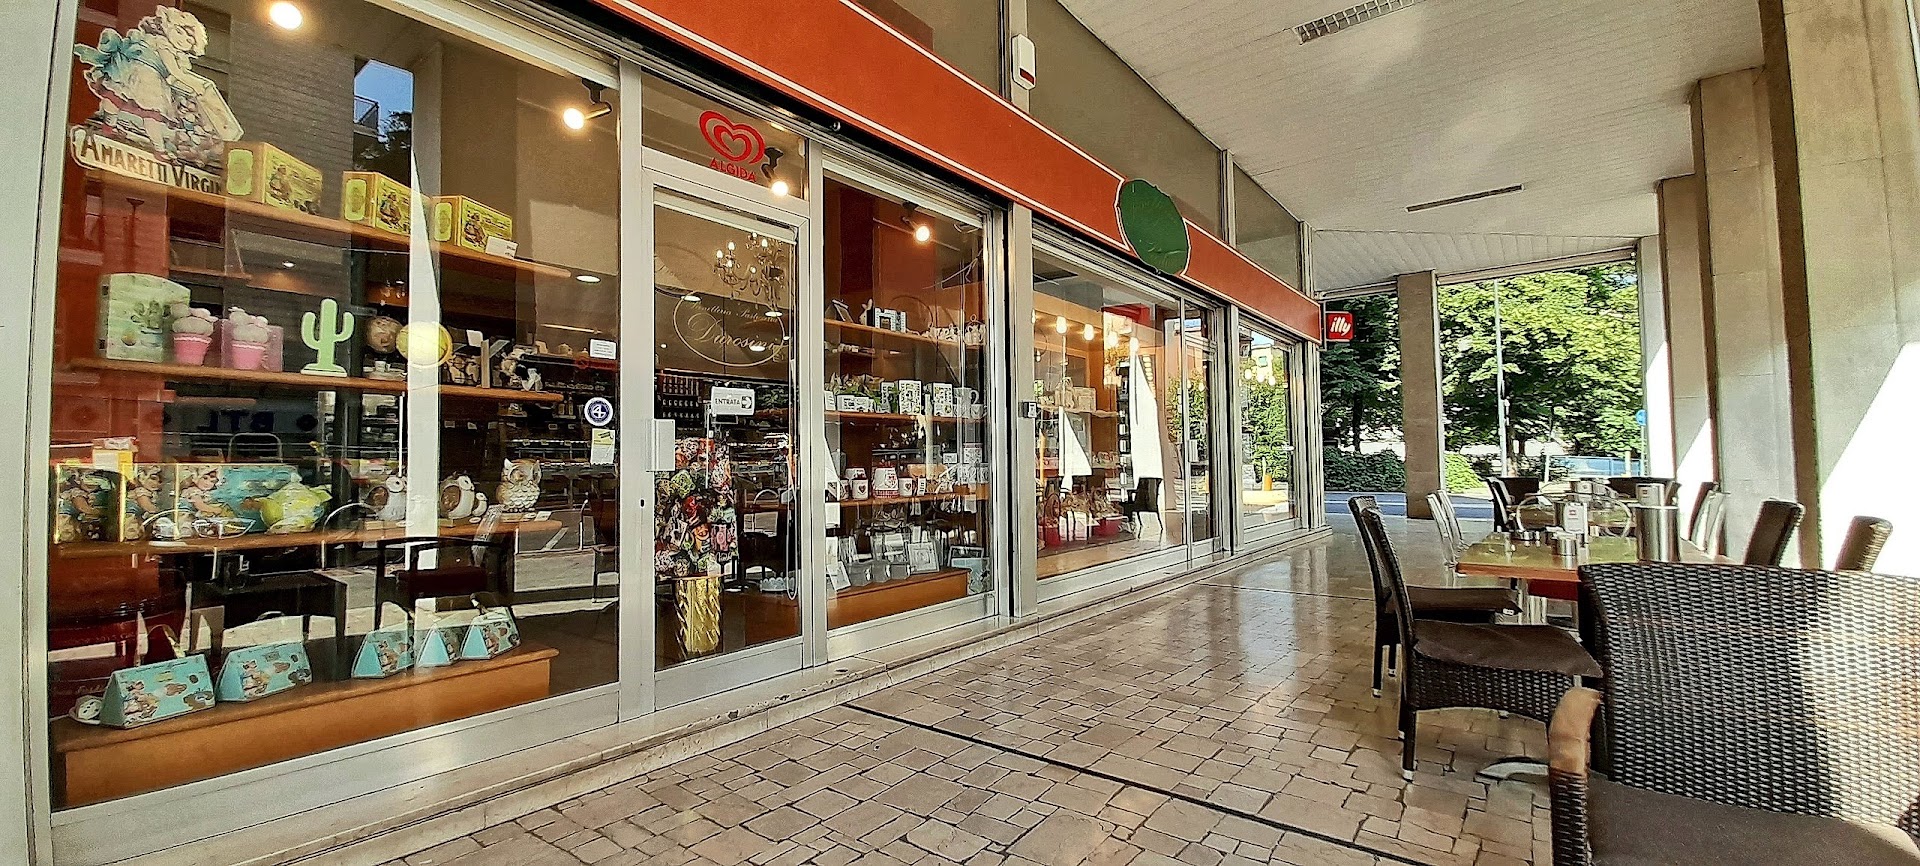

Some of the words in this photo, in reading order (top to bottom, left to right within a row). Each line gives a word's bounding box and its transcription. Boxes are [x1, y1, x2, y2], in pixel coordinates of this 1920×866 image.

[80, 132, 168, 183] AMARETTI
[709, 157, 757, 183] ALGIDA
[1330, 316, 1352, 337] illy
